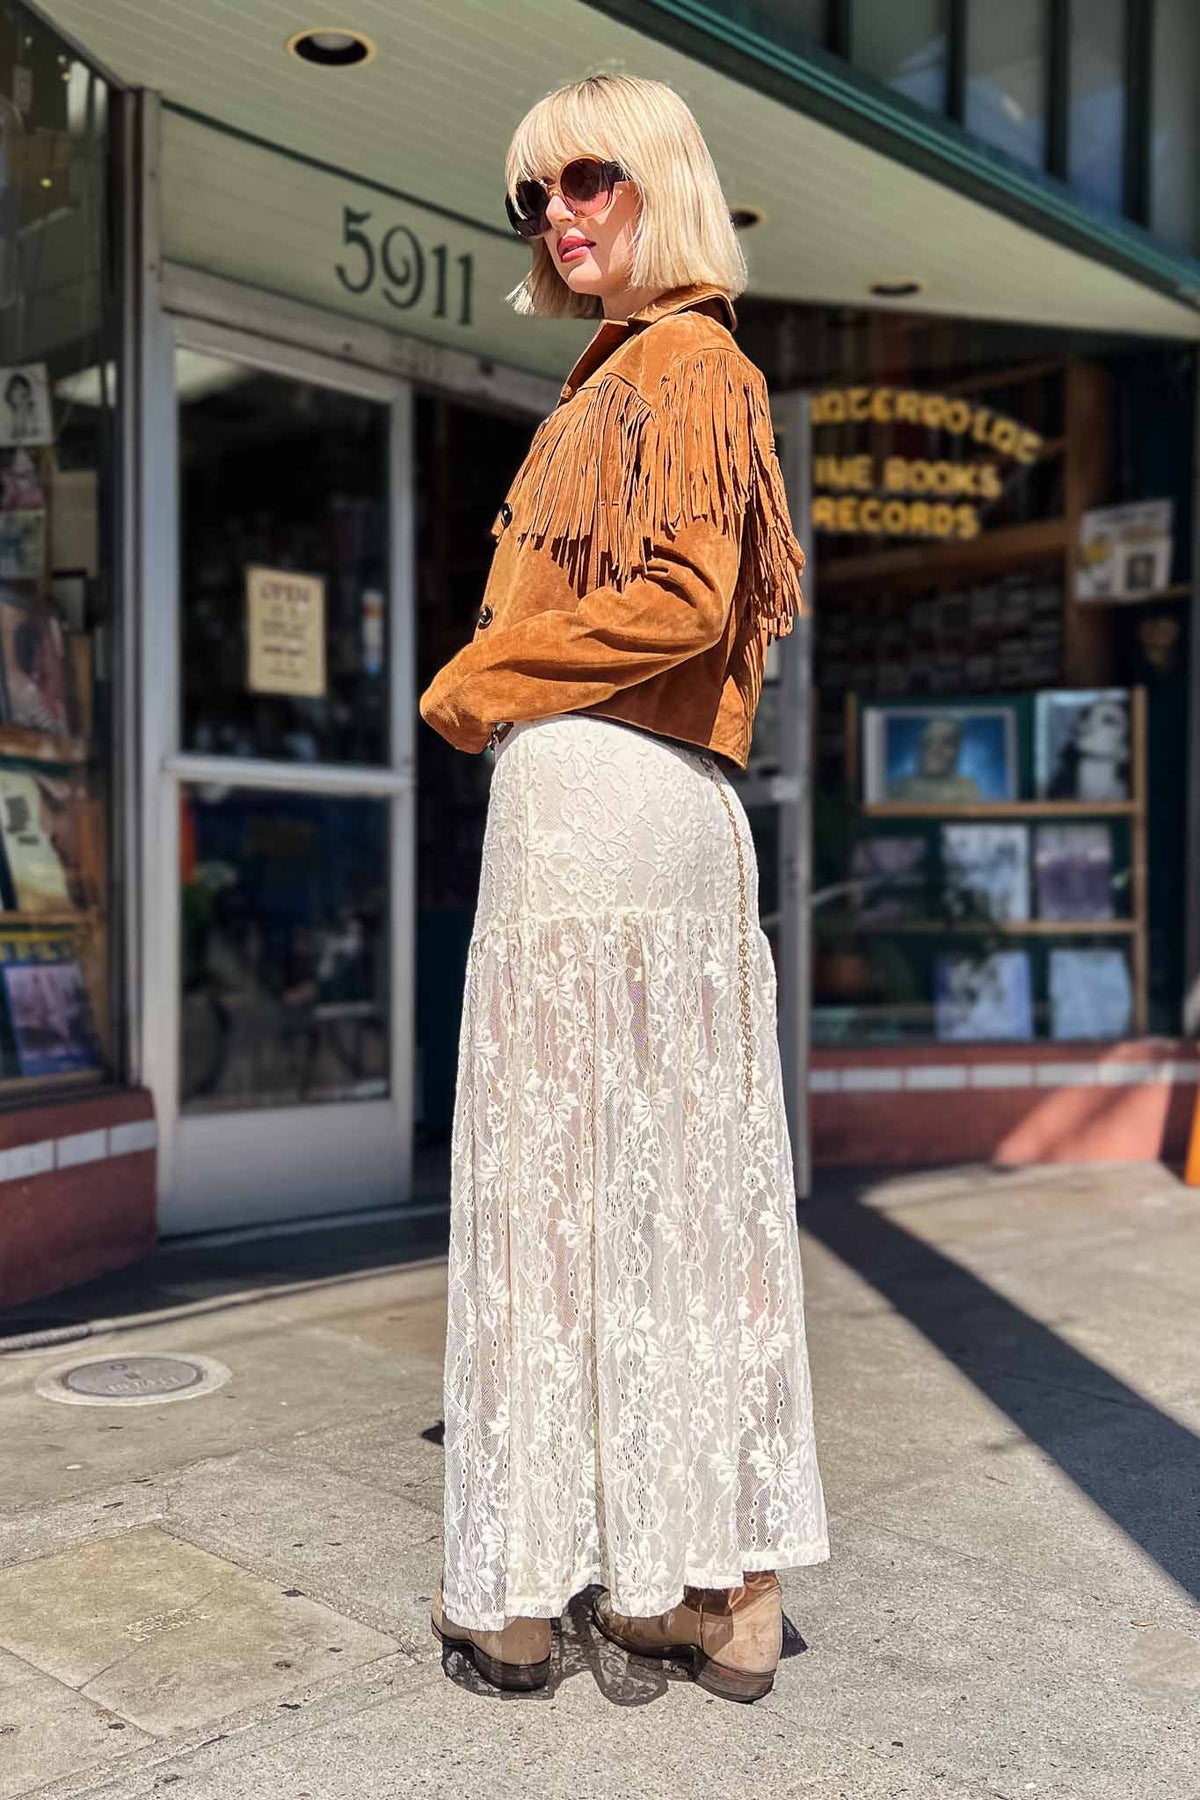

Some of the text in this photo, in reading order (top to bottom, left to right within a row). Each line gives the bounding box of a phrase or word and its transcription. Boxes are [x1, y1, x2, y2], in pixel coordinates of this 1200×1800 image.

[334, 206, 473, 326] 5911
[884, 457, 1001, 498] BOOKS
[812, 497, 980, 539] RECORDS
